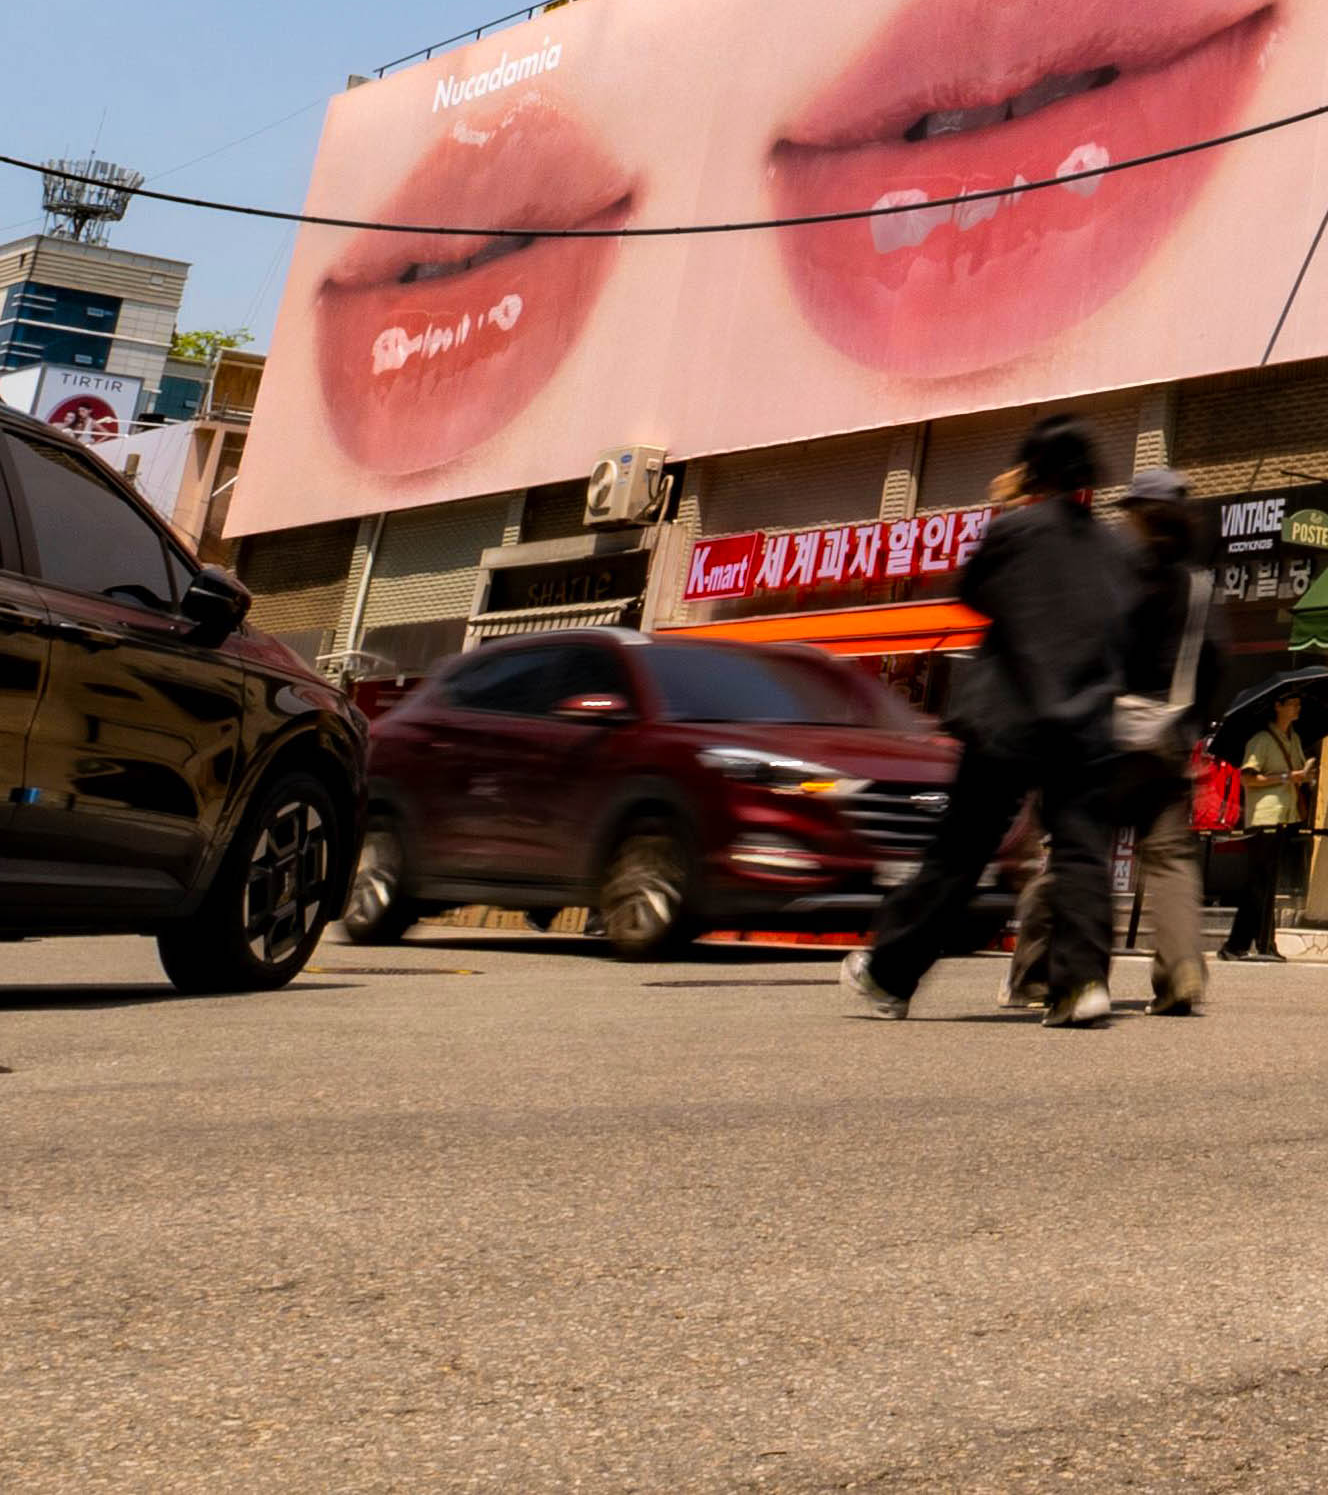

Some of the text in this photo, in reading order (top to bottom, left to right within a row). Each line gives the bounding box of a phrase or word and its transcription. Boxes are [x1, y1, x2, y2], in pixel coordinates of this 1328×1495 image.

[431, 34, 563, 114] Nucadamia
[61, 372, 123, 393] TIRTIR
[1221, 497, 1286, 538] VINTAGE
